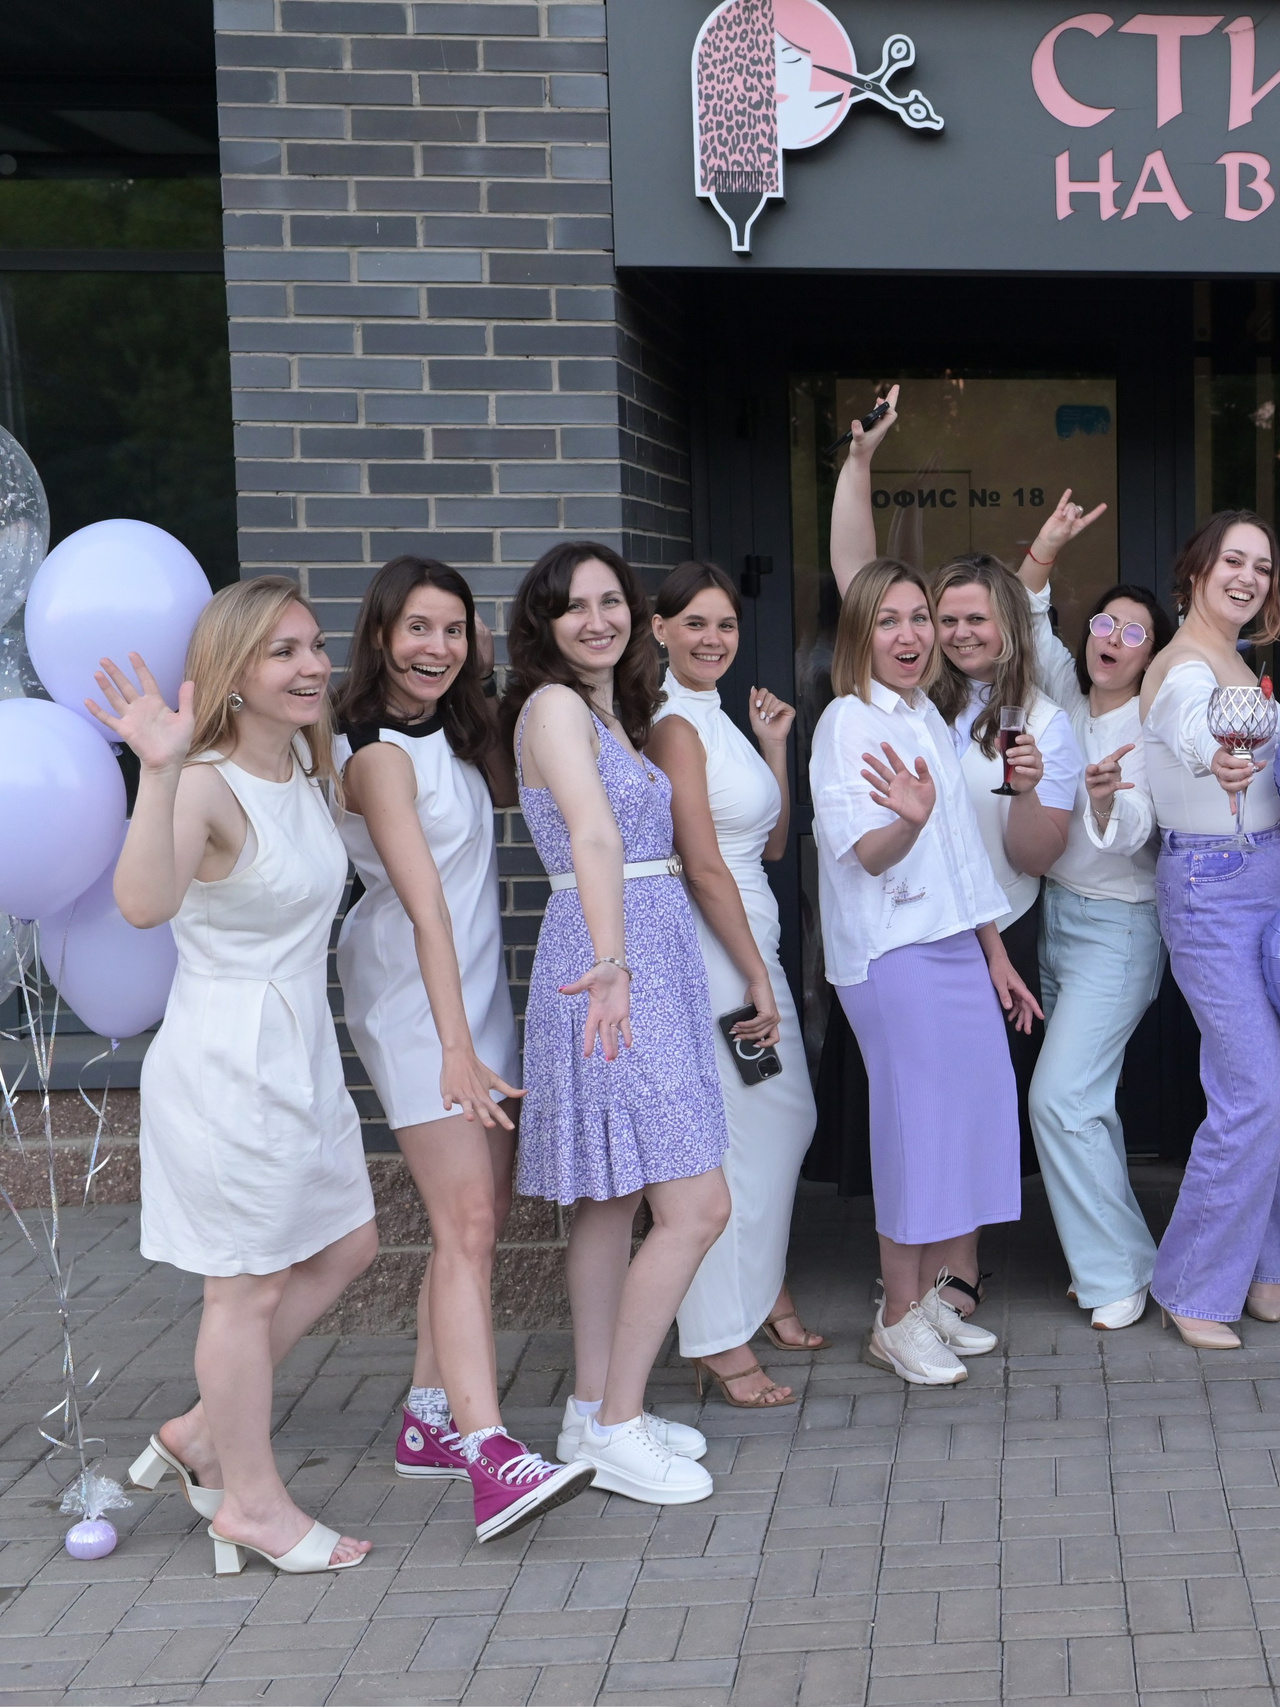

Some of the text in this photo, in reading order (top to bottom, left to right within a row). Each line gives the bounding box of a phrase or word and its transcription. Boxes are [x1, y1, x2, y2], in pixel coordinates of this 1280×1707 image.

[1053, 150, 1192, 221] НА
[871, 487, 1044, 509] ОФИС № 18
